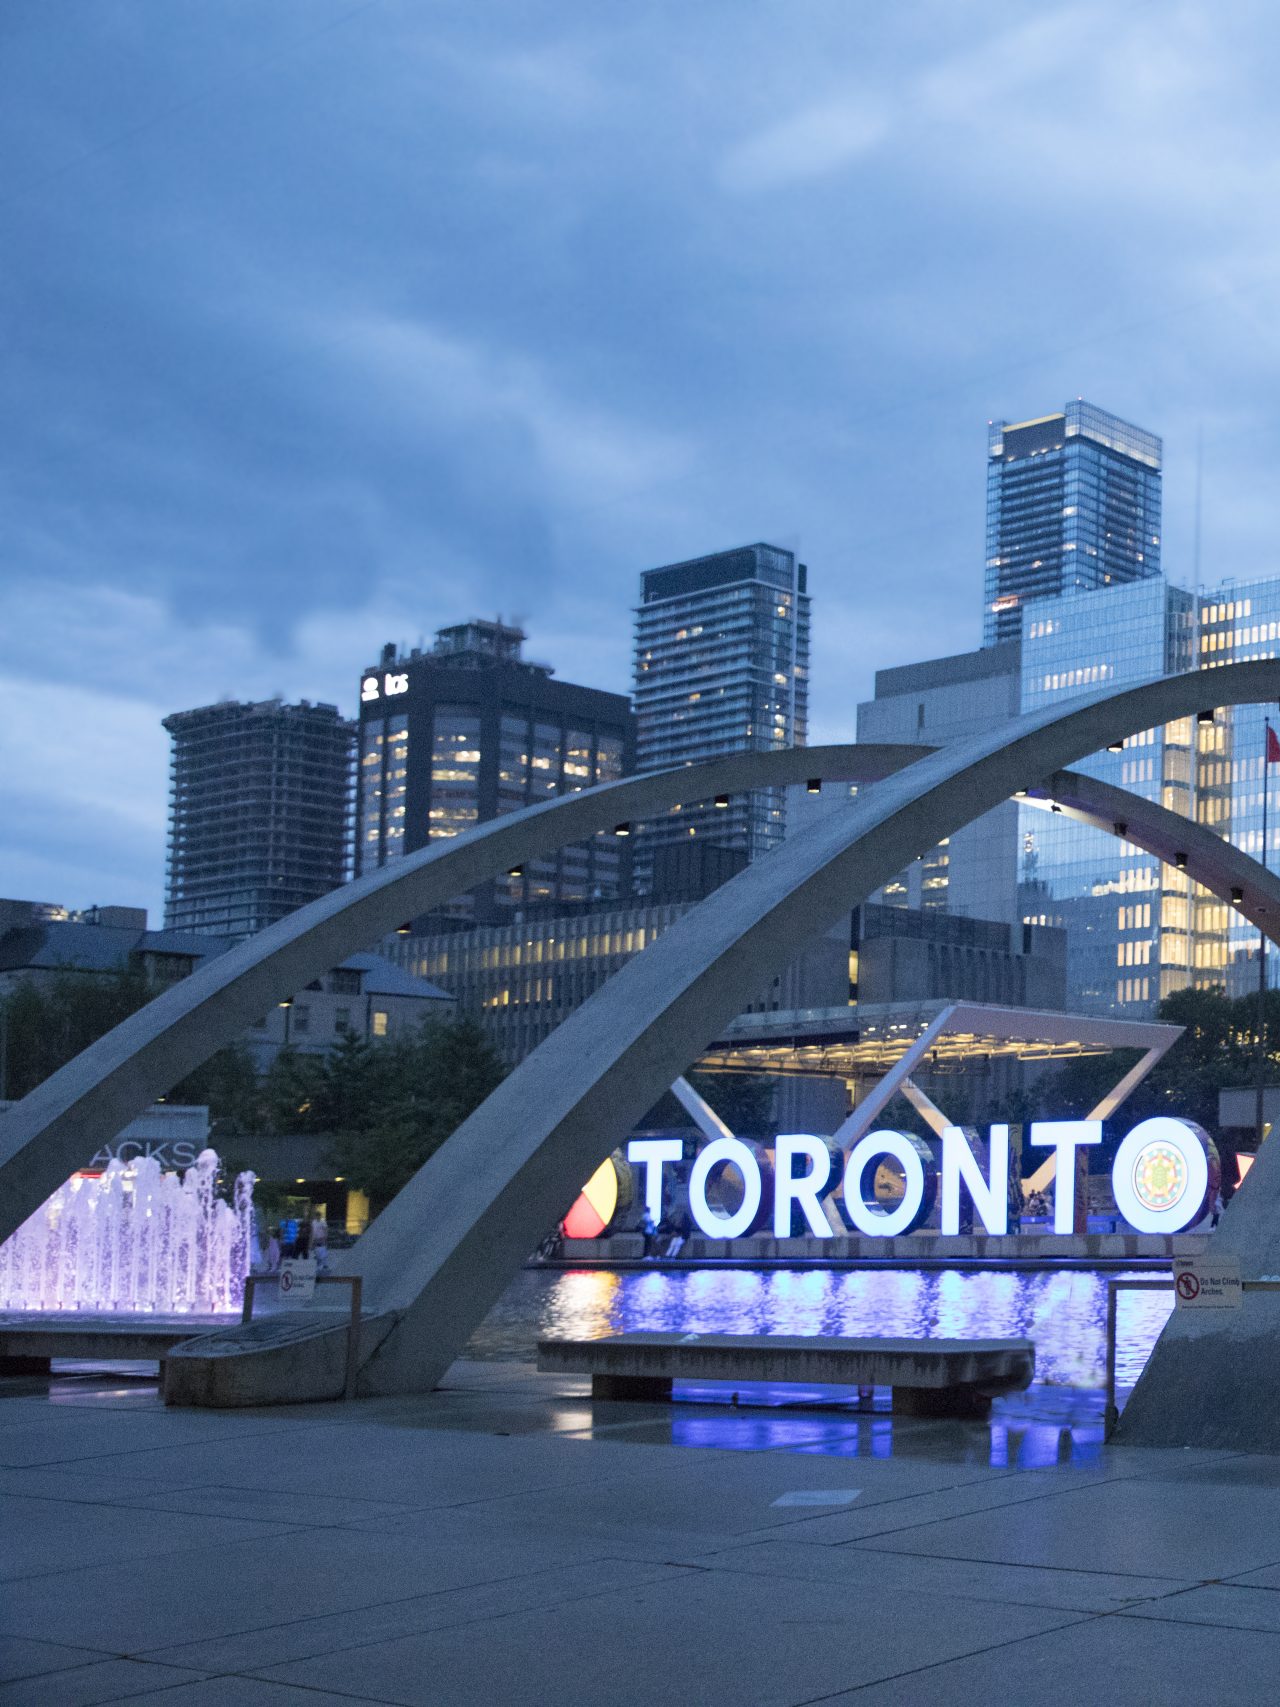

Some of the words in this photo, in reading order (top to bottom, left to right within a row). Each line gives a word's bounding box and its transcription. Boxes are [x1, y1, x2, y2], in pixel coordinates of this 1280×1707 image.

[627, 1116, 1208, 1239] TORONTO
[1200, 1277, 1209, 1286] Do
[1210, 1277, 1221, 1286] Not
[1222, 1277, 1240, 1287] Climb
